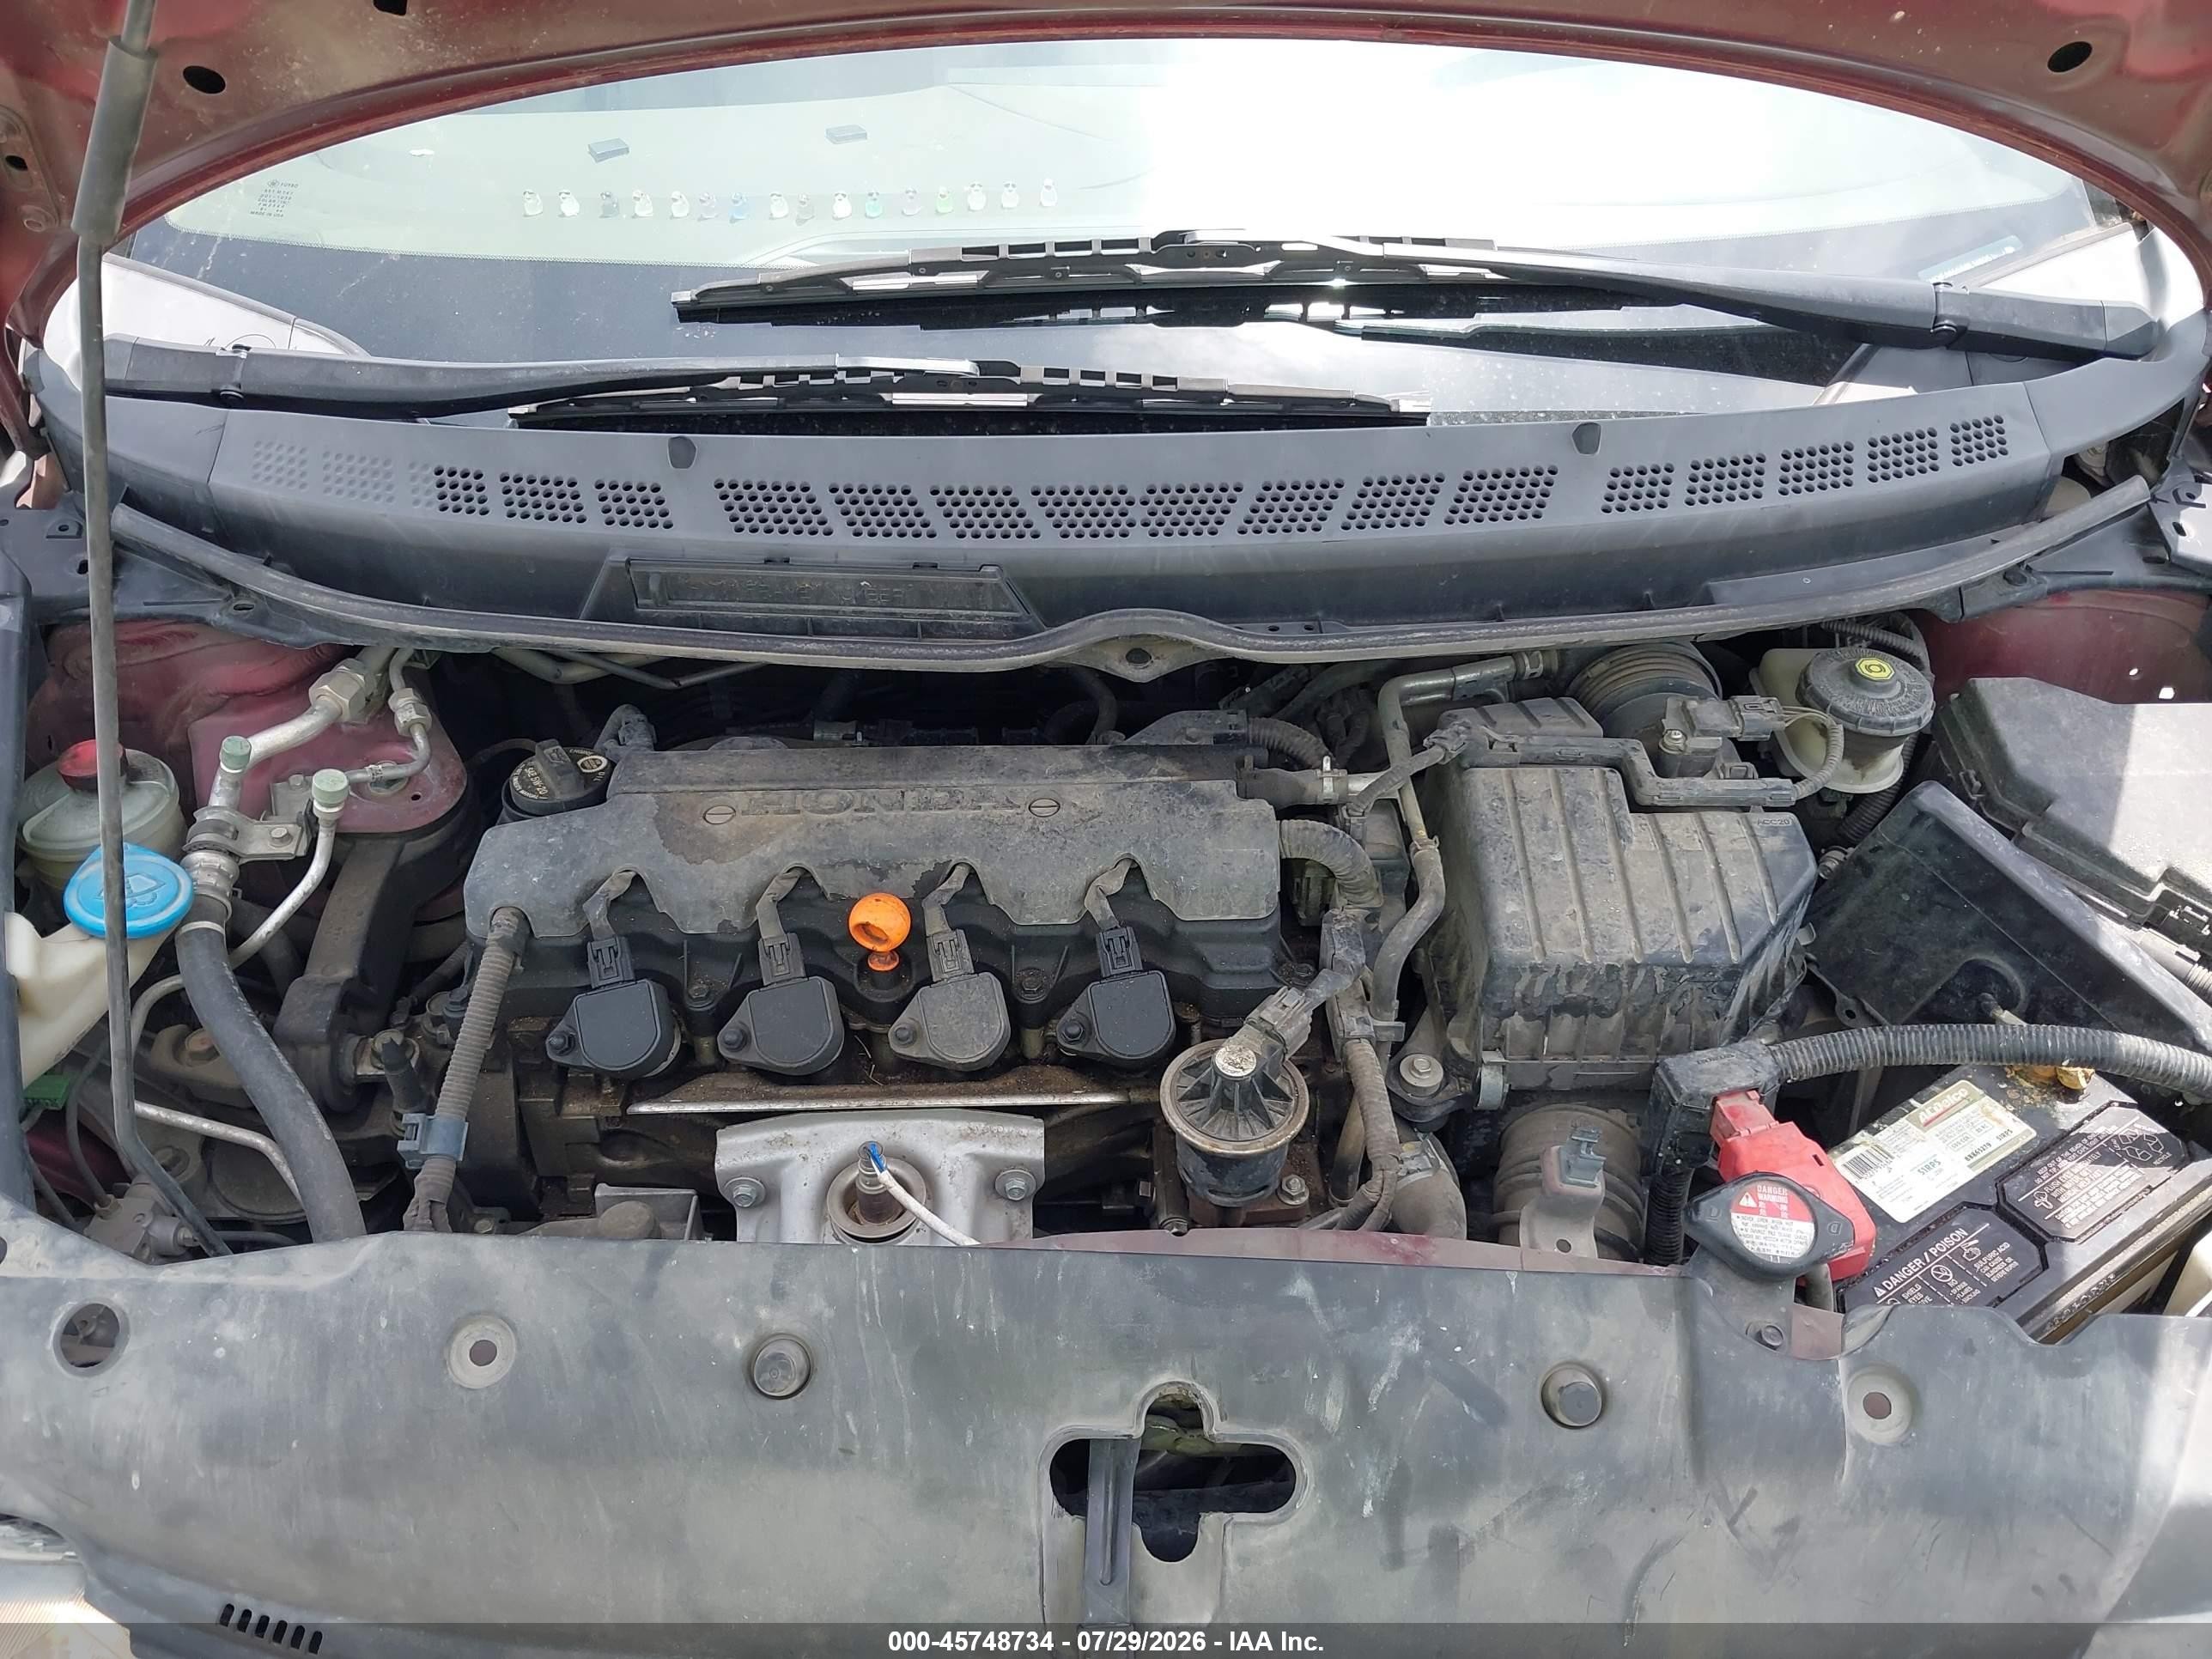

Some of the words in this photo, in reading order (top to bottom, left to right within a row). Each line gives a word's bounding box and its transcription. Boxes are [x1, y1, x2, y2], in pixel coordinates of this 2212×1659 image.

[1918, 1088, 1968, 1124] ACDelco
[1757, 1185, 1788, 1196] DANGER
[1882, 1258, 1925, 1291] DANGER
[1928, 1228, 1969, 1257] POISON
[1901, 1284, 1922, 1300] SHIELD
